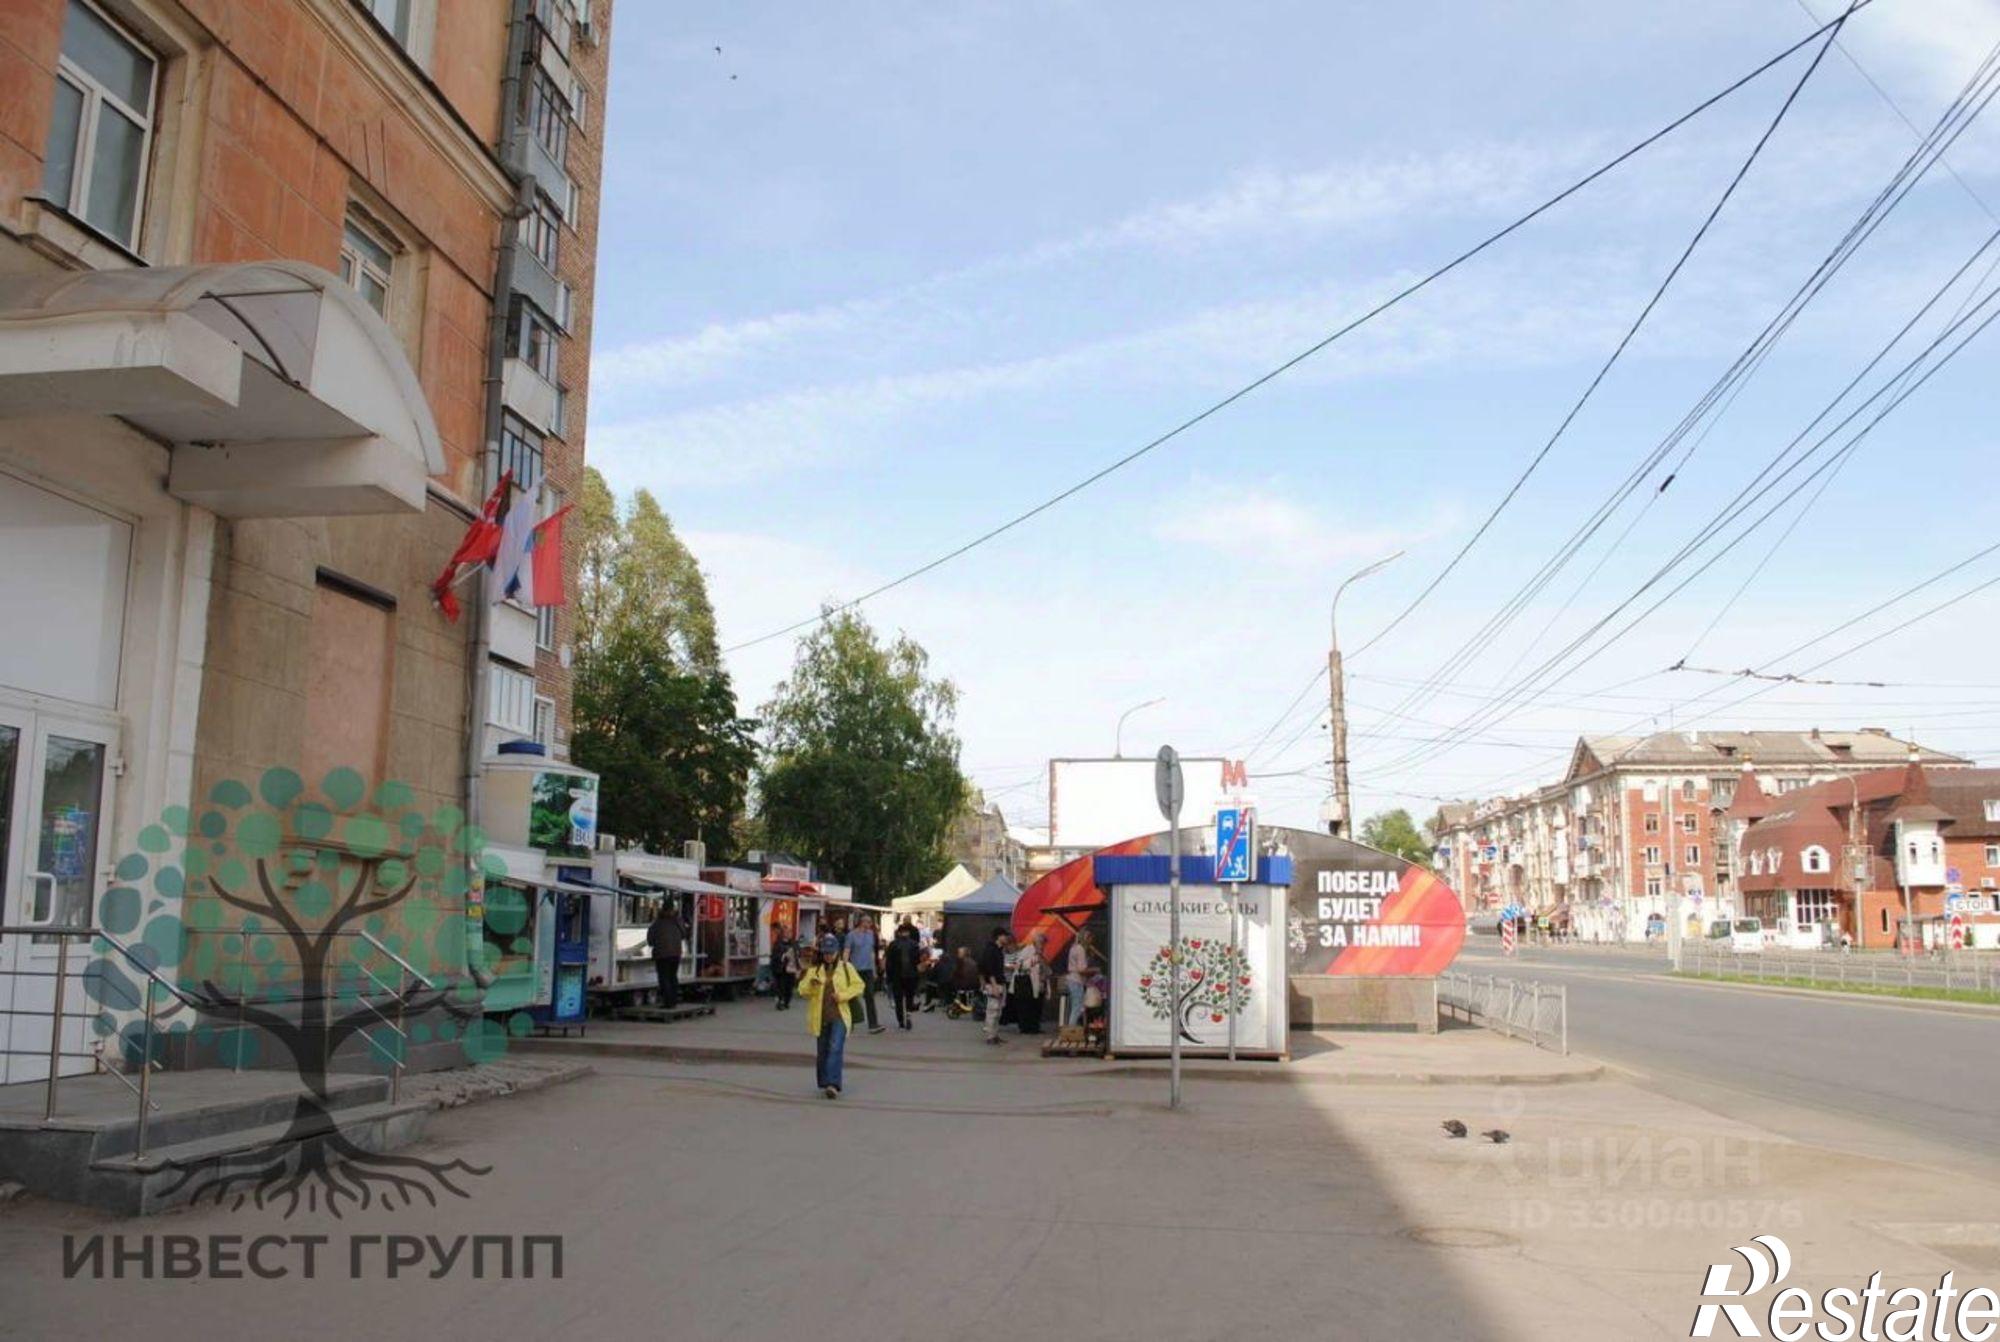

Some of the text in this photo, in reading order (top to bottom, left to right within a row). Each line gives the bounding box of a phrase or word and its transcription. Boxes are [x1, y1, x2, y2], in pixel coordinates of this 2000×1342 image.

[1318, 870, 1400, 896] ПОБЕДА
[1132, 902, 1210, 914] СПАСКИЕ
[1318, 898, 1382, 922] БУДЕТ
[1320, 924, 1421, 947] ЗА НАМИ!
